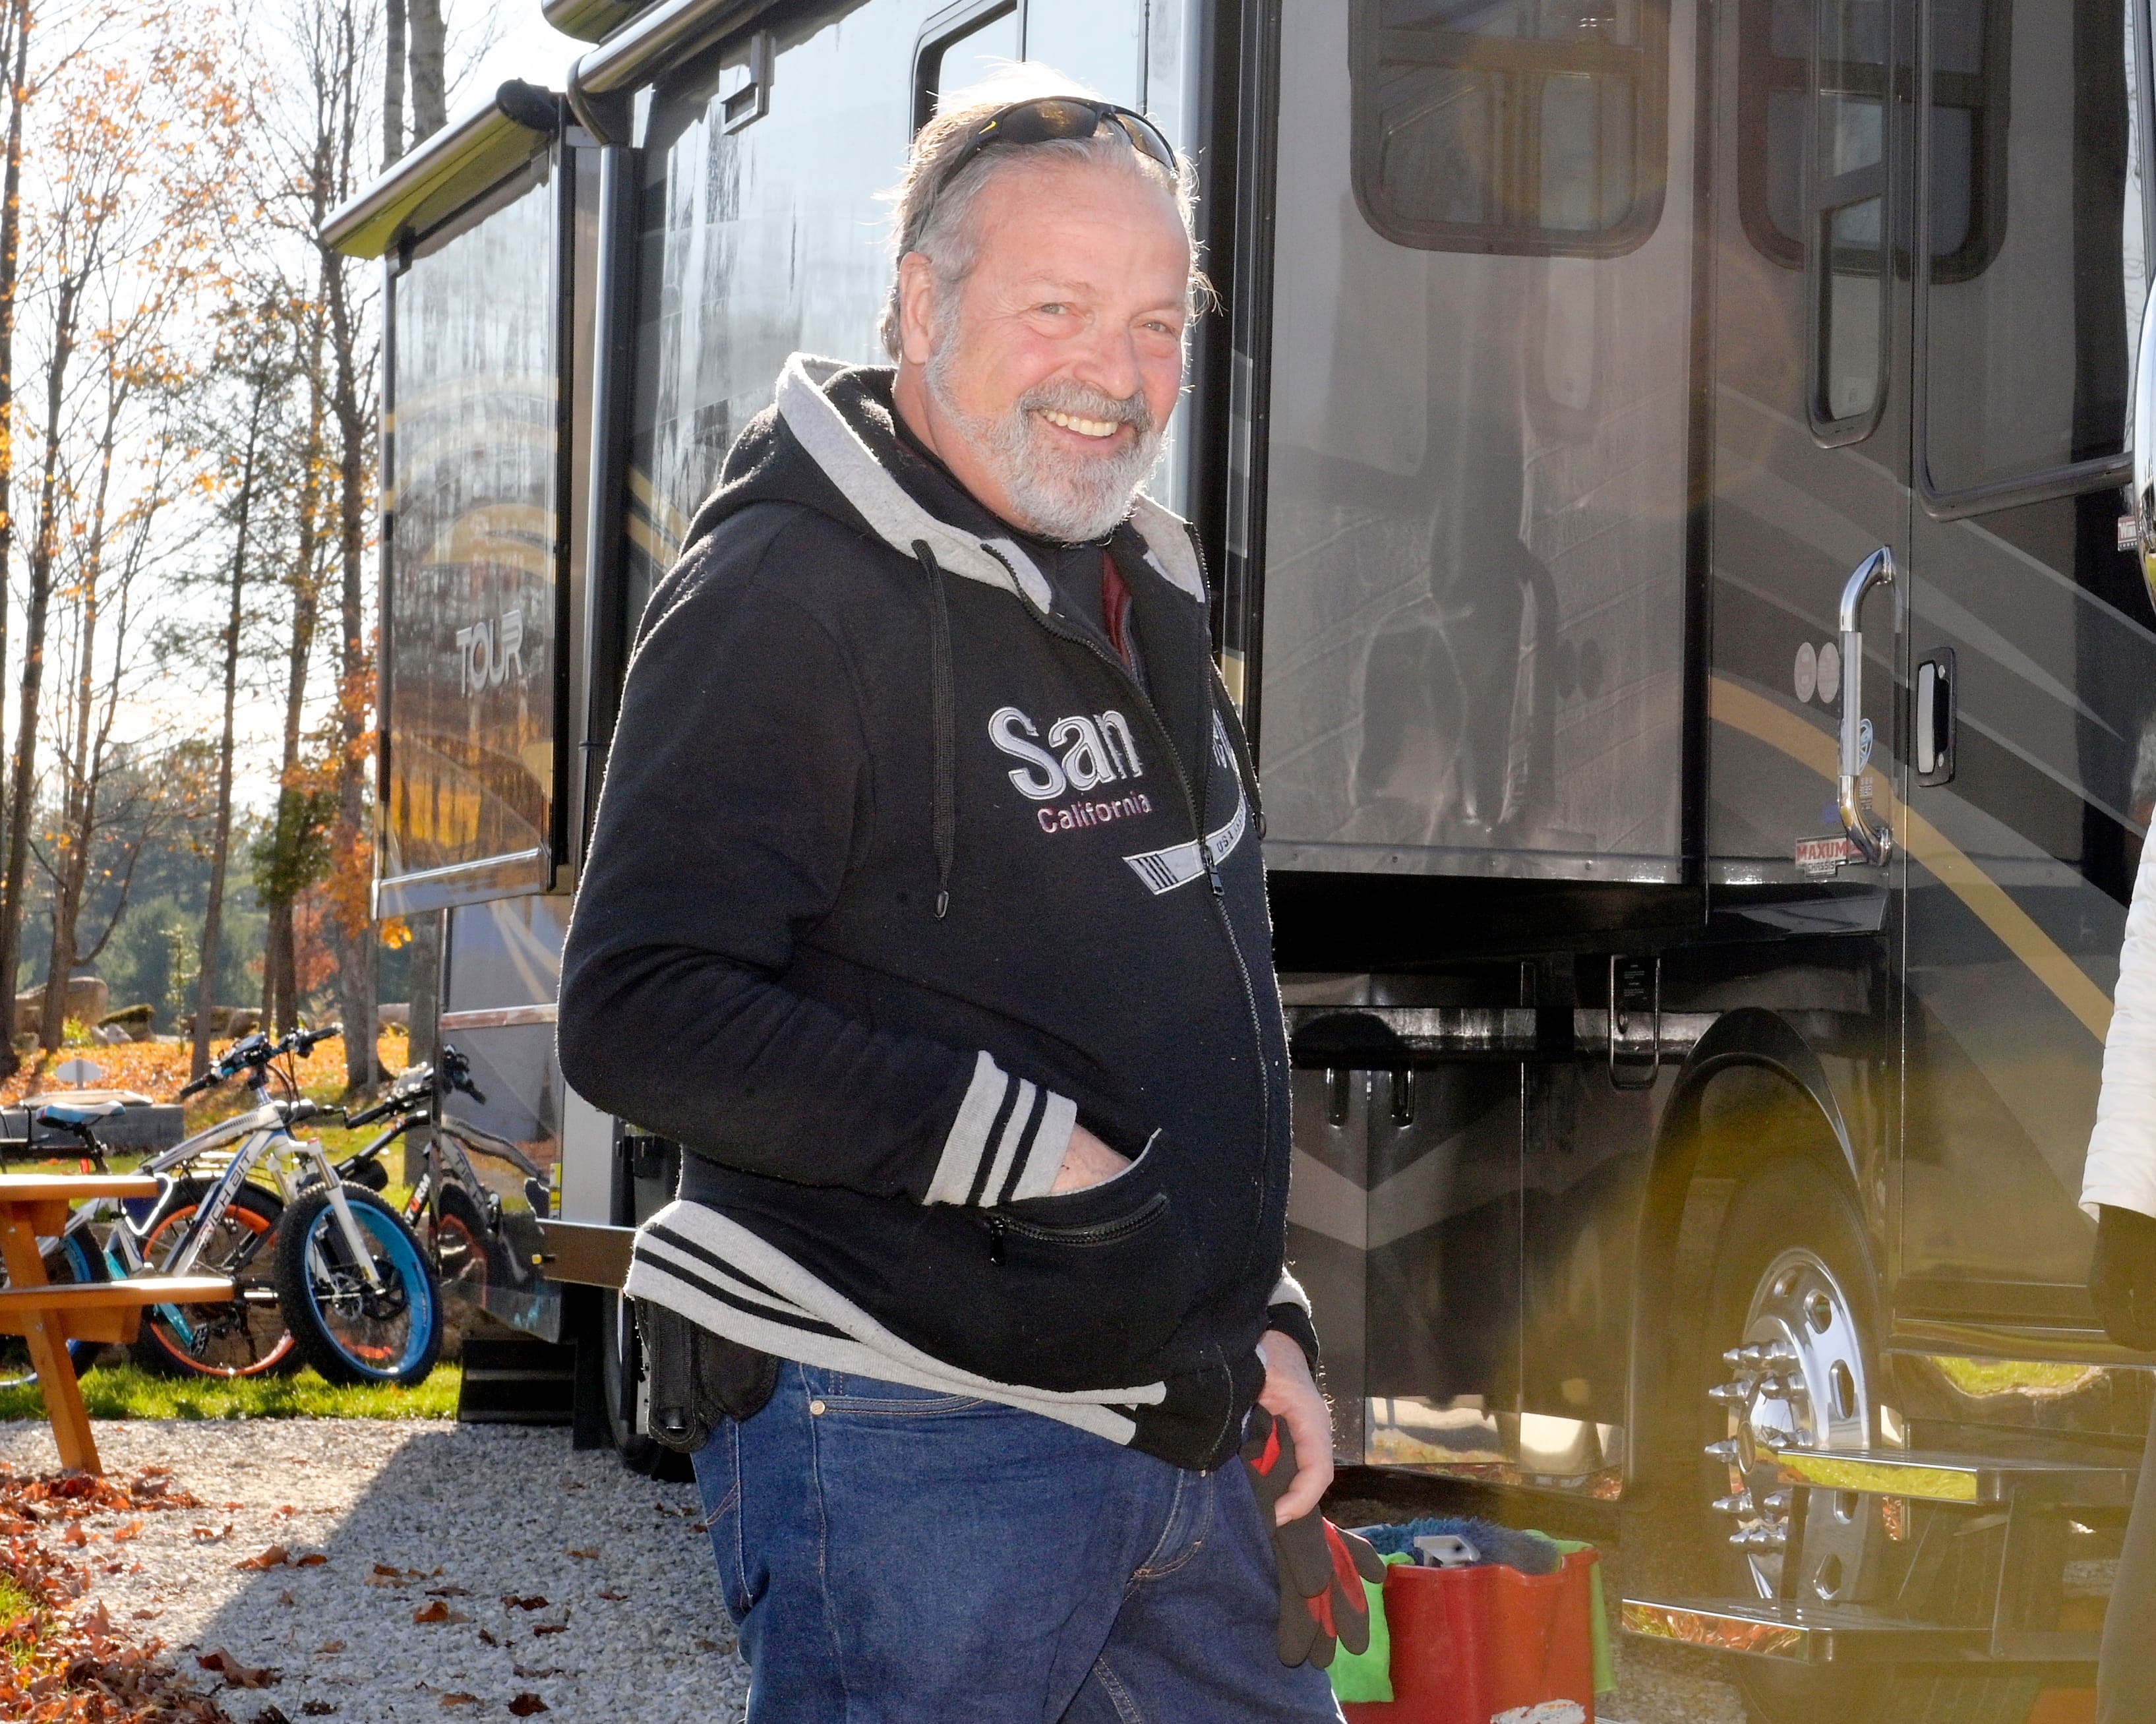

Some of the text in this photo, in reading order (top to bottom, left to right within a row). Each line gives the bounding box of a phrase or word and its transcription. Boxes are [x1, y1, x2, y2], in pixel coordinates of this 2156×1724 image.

[456, 609, 524, 697] TOUR
[988, 706, 1143, 800] San
[1037, 792, 1153, 833] California
[1796, 841, 1850, 859] MAXUM
[1808, 860, 1836, 871] CHASSIS
